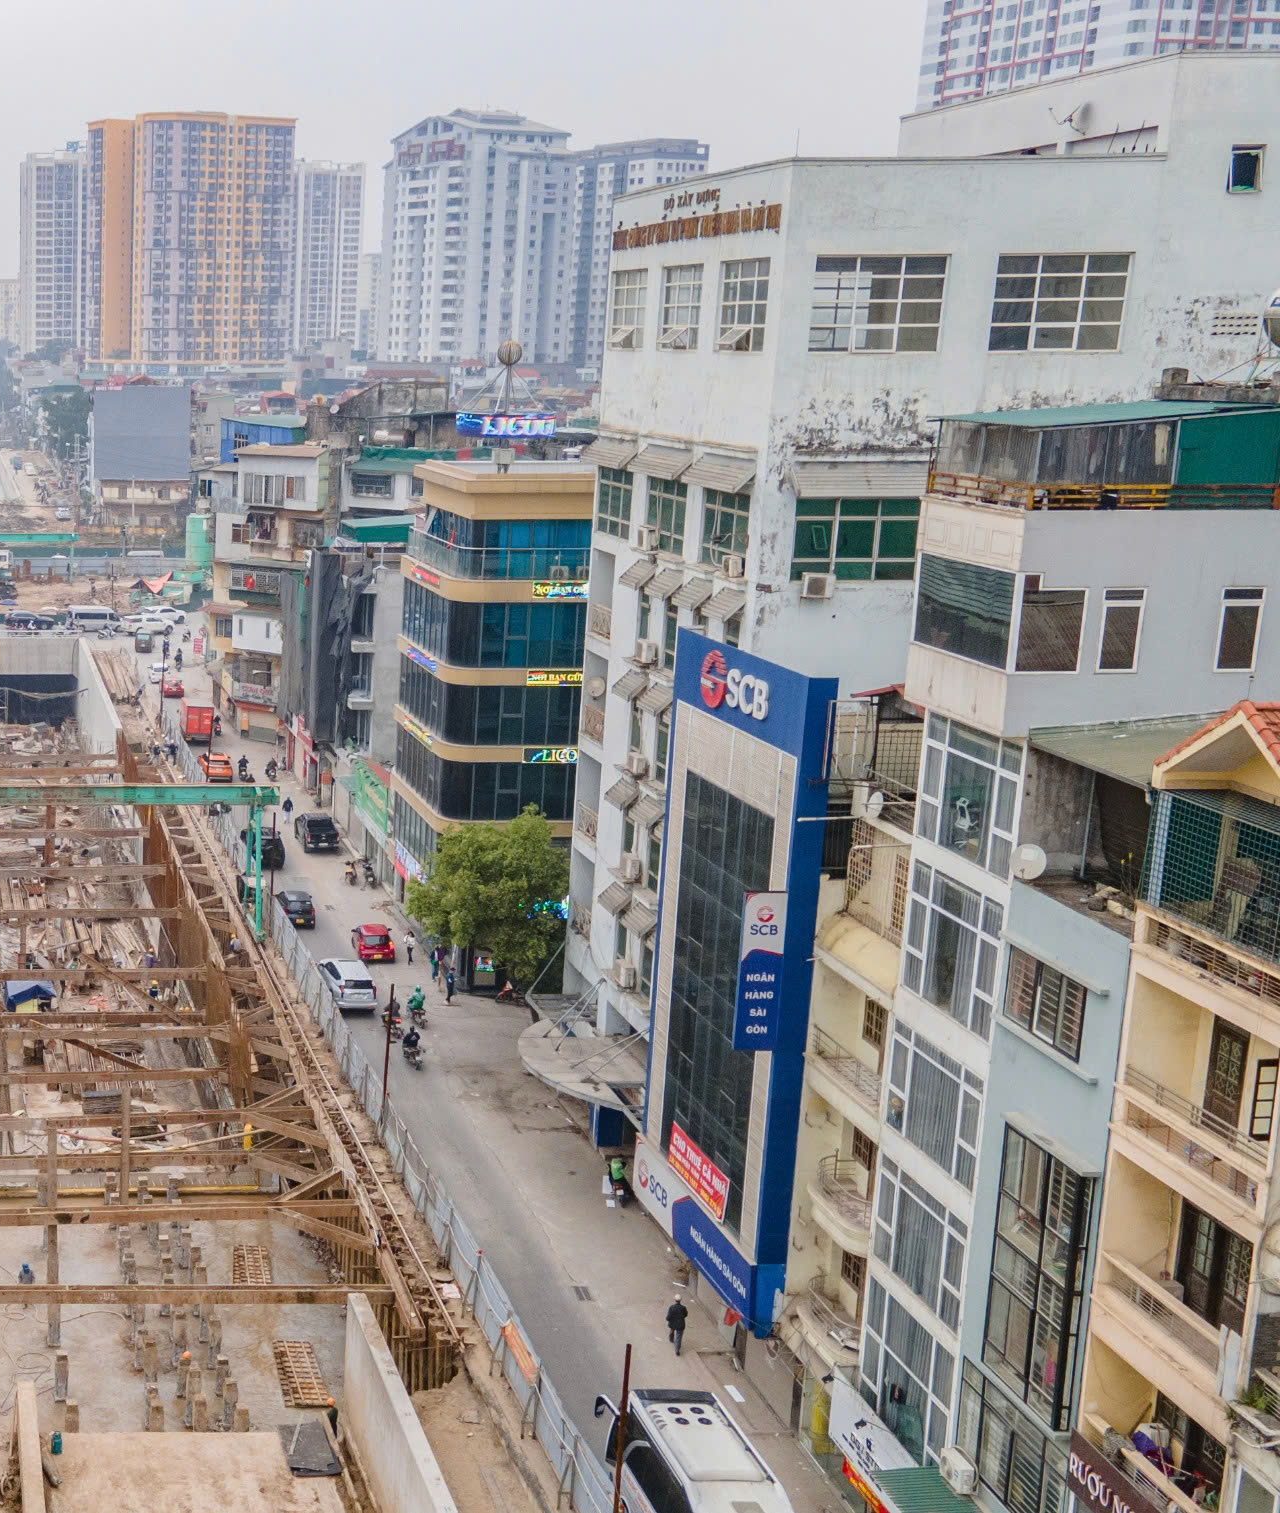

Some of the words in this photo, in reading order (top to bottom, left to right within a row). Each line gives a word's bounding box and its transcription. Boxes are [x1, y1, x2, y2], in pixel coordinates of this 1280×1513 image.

[725, 668, 769, 721] SCB
[750, 924, 778, 936] SCB
[746, 972, 775, 983] NGÂN
[745, 990, 774, 1000] HÀNG
[749, 1007, 767, 1017] SÀI
[745, 1024, 768, 1034] GÒN
[649, 1174, 668, 1208] SCB
[690, 1225, 706, 1252] NGÂN
[706, 1243, 723, 1271] HÀNG
[722, 1263, 733, 1283] SÀI
[732, 1275, 746, 1299] GÒN
[1069, 1452, 1113, 1507] RƯỢU
